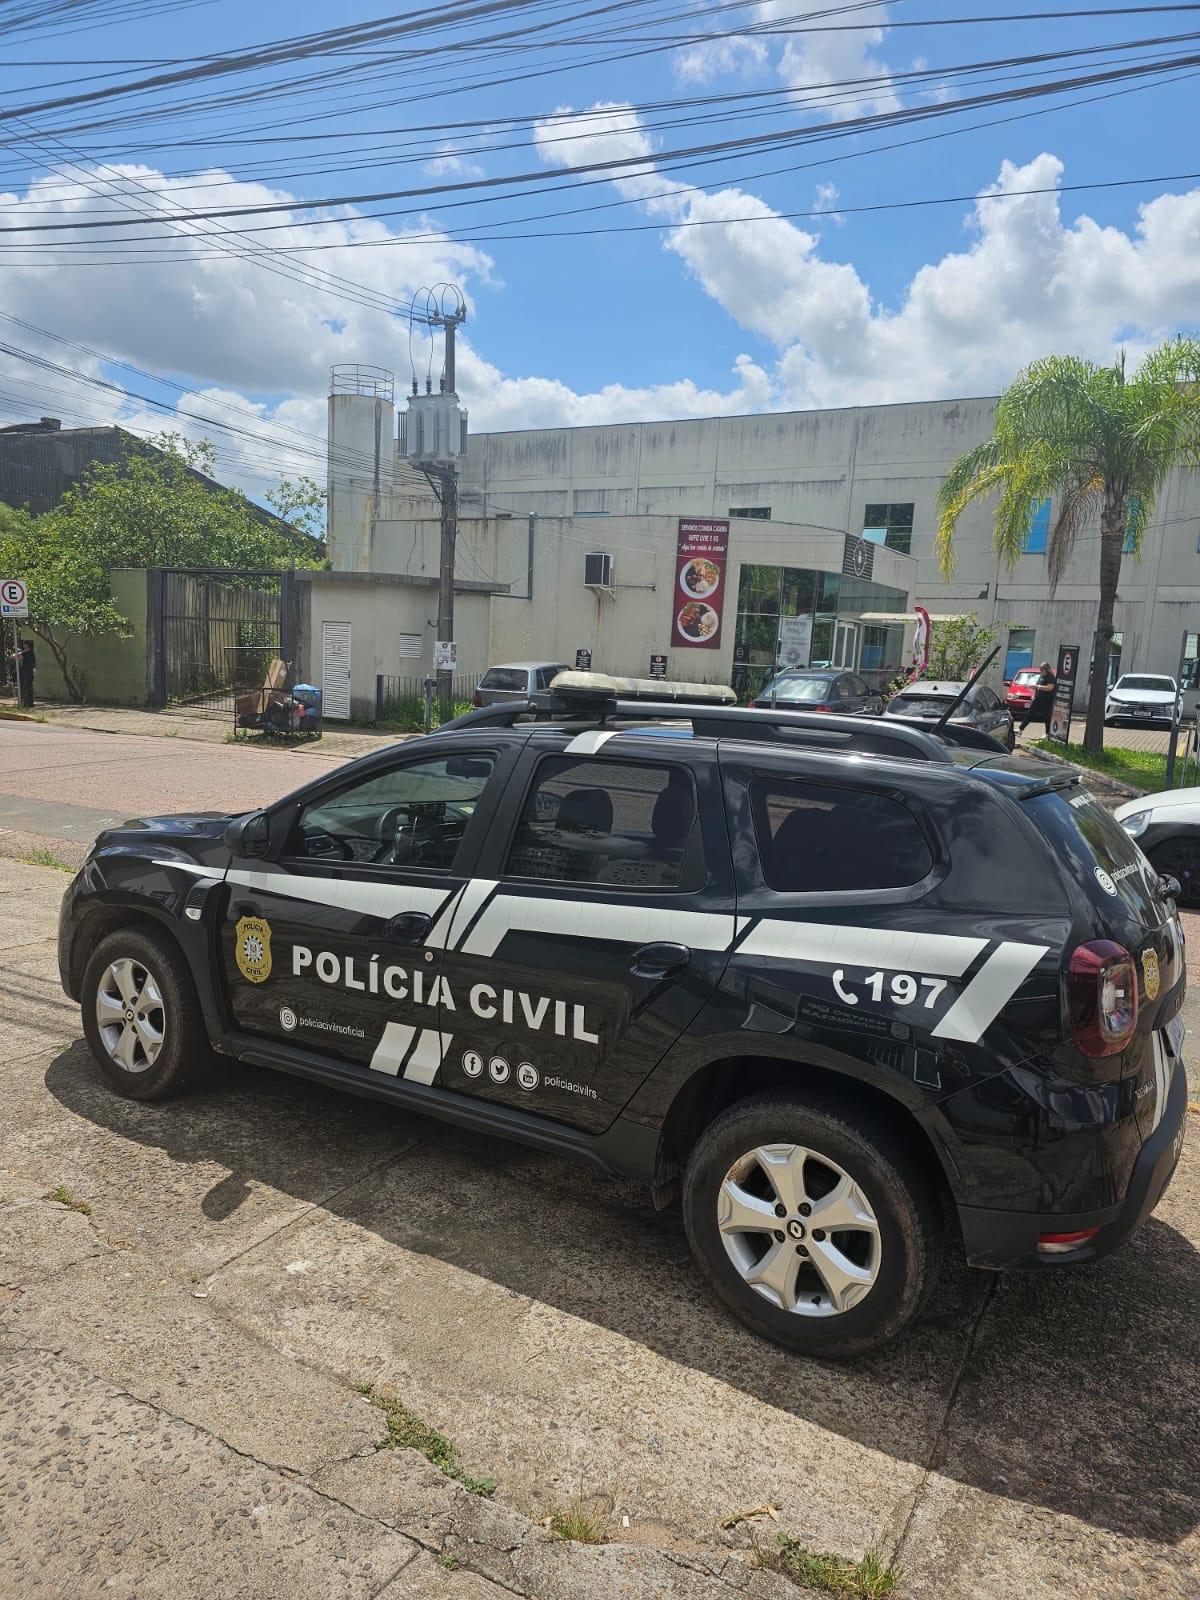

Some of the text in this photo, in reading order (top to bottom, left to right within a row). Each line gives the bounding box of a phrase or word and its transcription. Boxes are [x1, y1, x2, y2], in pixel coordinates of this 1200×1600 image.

[9, 586, 18, 600] E
[292, 945, 599, 1044] POLÍCIA CIVIL
[864, 971, 948, 1009] 197
[300, 1017, 365, 1038] policiacivilrsoficial
[544, 1076, 597, 1099] policiacivilrs
